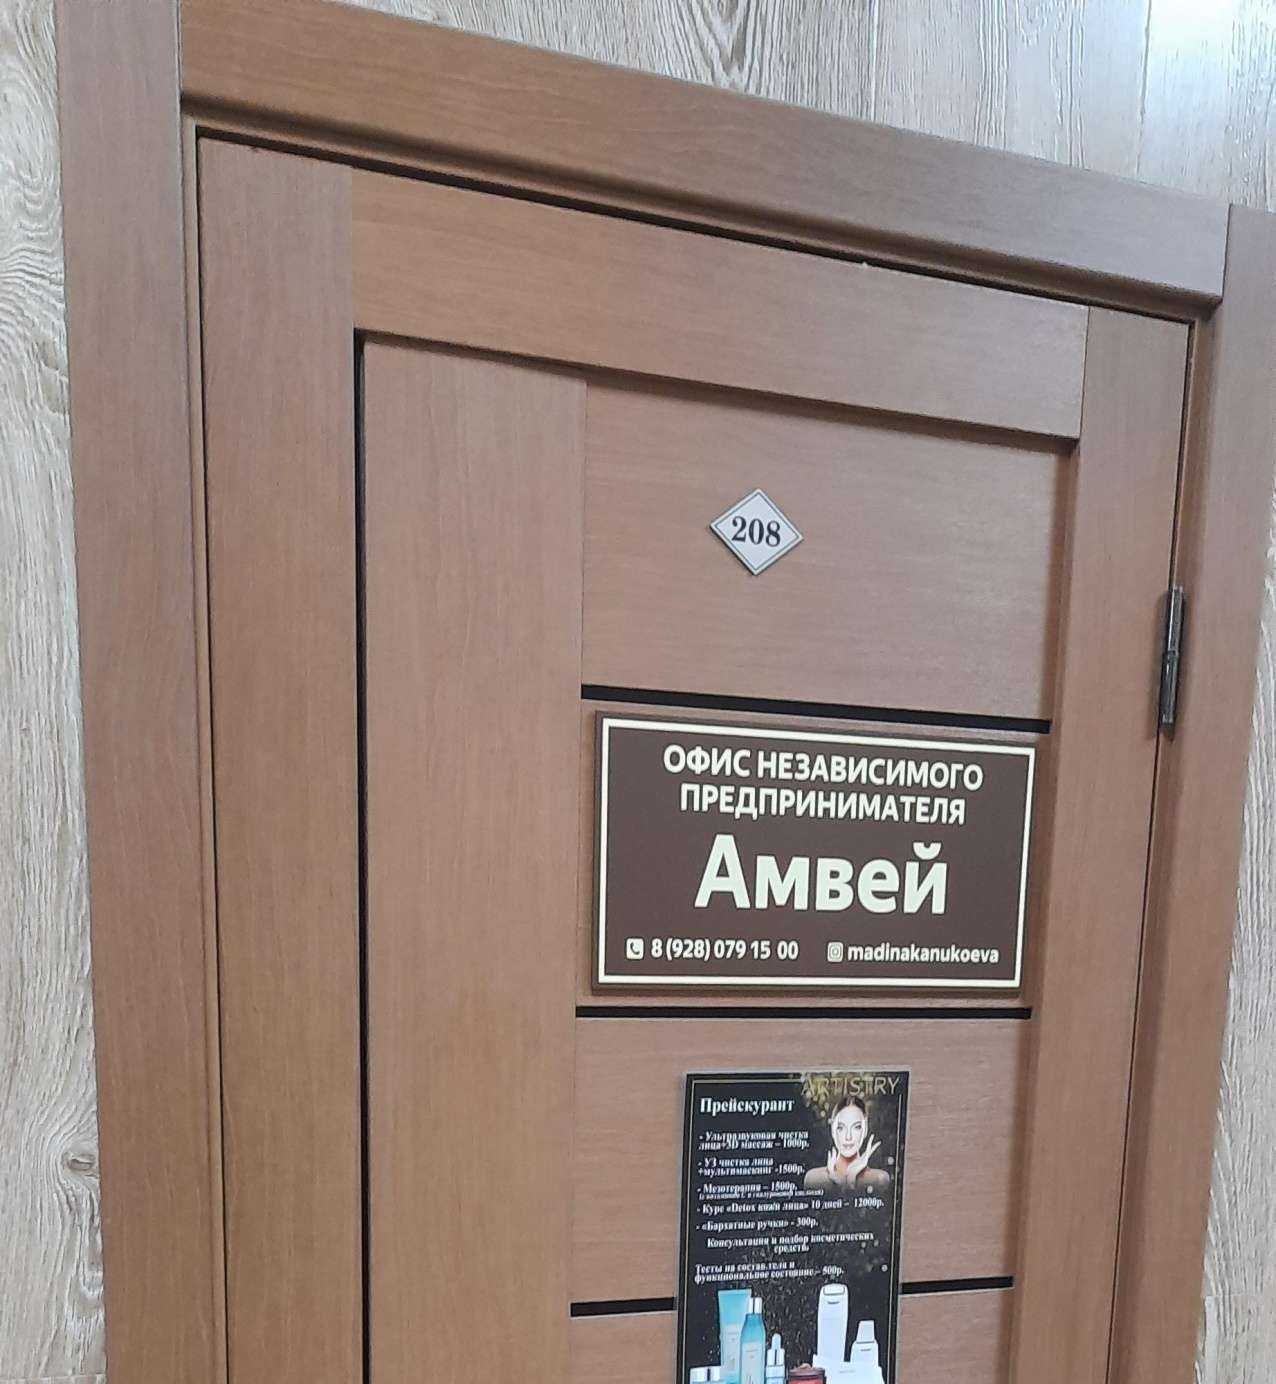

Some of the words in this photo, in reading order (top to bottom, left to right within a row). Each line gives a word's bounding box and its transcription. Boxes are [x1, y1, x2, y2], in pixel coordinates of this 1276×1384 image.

[731, 515, 781, 547] 208
[663, 744, 751, 778] ОФИС
[757, 751, 984, 791] НЕЗАВИСИМОГО
[680, 783, 966, 825] ПРЕДПРИНИМАТЕЛЯ
[694, 833, 948, 915] Амвей
[650, 938, 663, 958] 8
[665, 938, 711, 961] (928)
[714, 940, 746, 960] 079
[750, 940, 771, 960] 15
[777, 941, 799, 961] 00
[847, 942, 999, 964] madinakanukoeva
[801, 1077, 900, 1095] ARTISTRY
[700, 1097, 795, 1117] Прейскурант
[741, 1140, 774, 1149] массаж
[783, 1138, 809, 1150] 1000р.
[778, 1131, 809, 1140] чистка
[719, 1158, 750, 1167] чистка
[751, 1158, 774, 1166] лица
[703, 1183, 761, 1195] Мезотерапия
[771, 1181, 798, 1192] 1500р.
[702, 1204, 724, 1216] Курс
[757, 1203, 781, 1212] кожи
[811, 1200, 821, 1209] 10
[822, 1199, 843, 1210] дней
[853, 1197, 885, 1209] 12000р.
[702, 1221, 756, 1232] «Бархатные
[796, 1217, 819, 1228] 300р.
[779, 1235, 809, 1246] подбор
[810, 1232, 874, 1243] косметических
[694, 1271, 769, 1284] функциональное
[695, 1264, 723, 1274] Тесты
[724, 1264, 735, 1272] на
